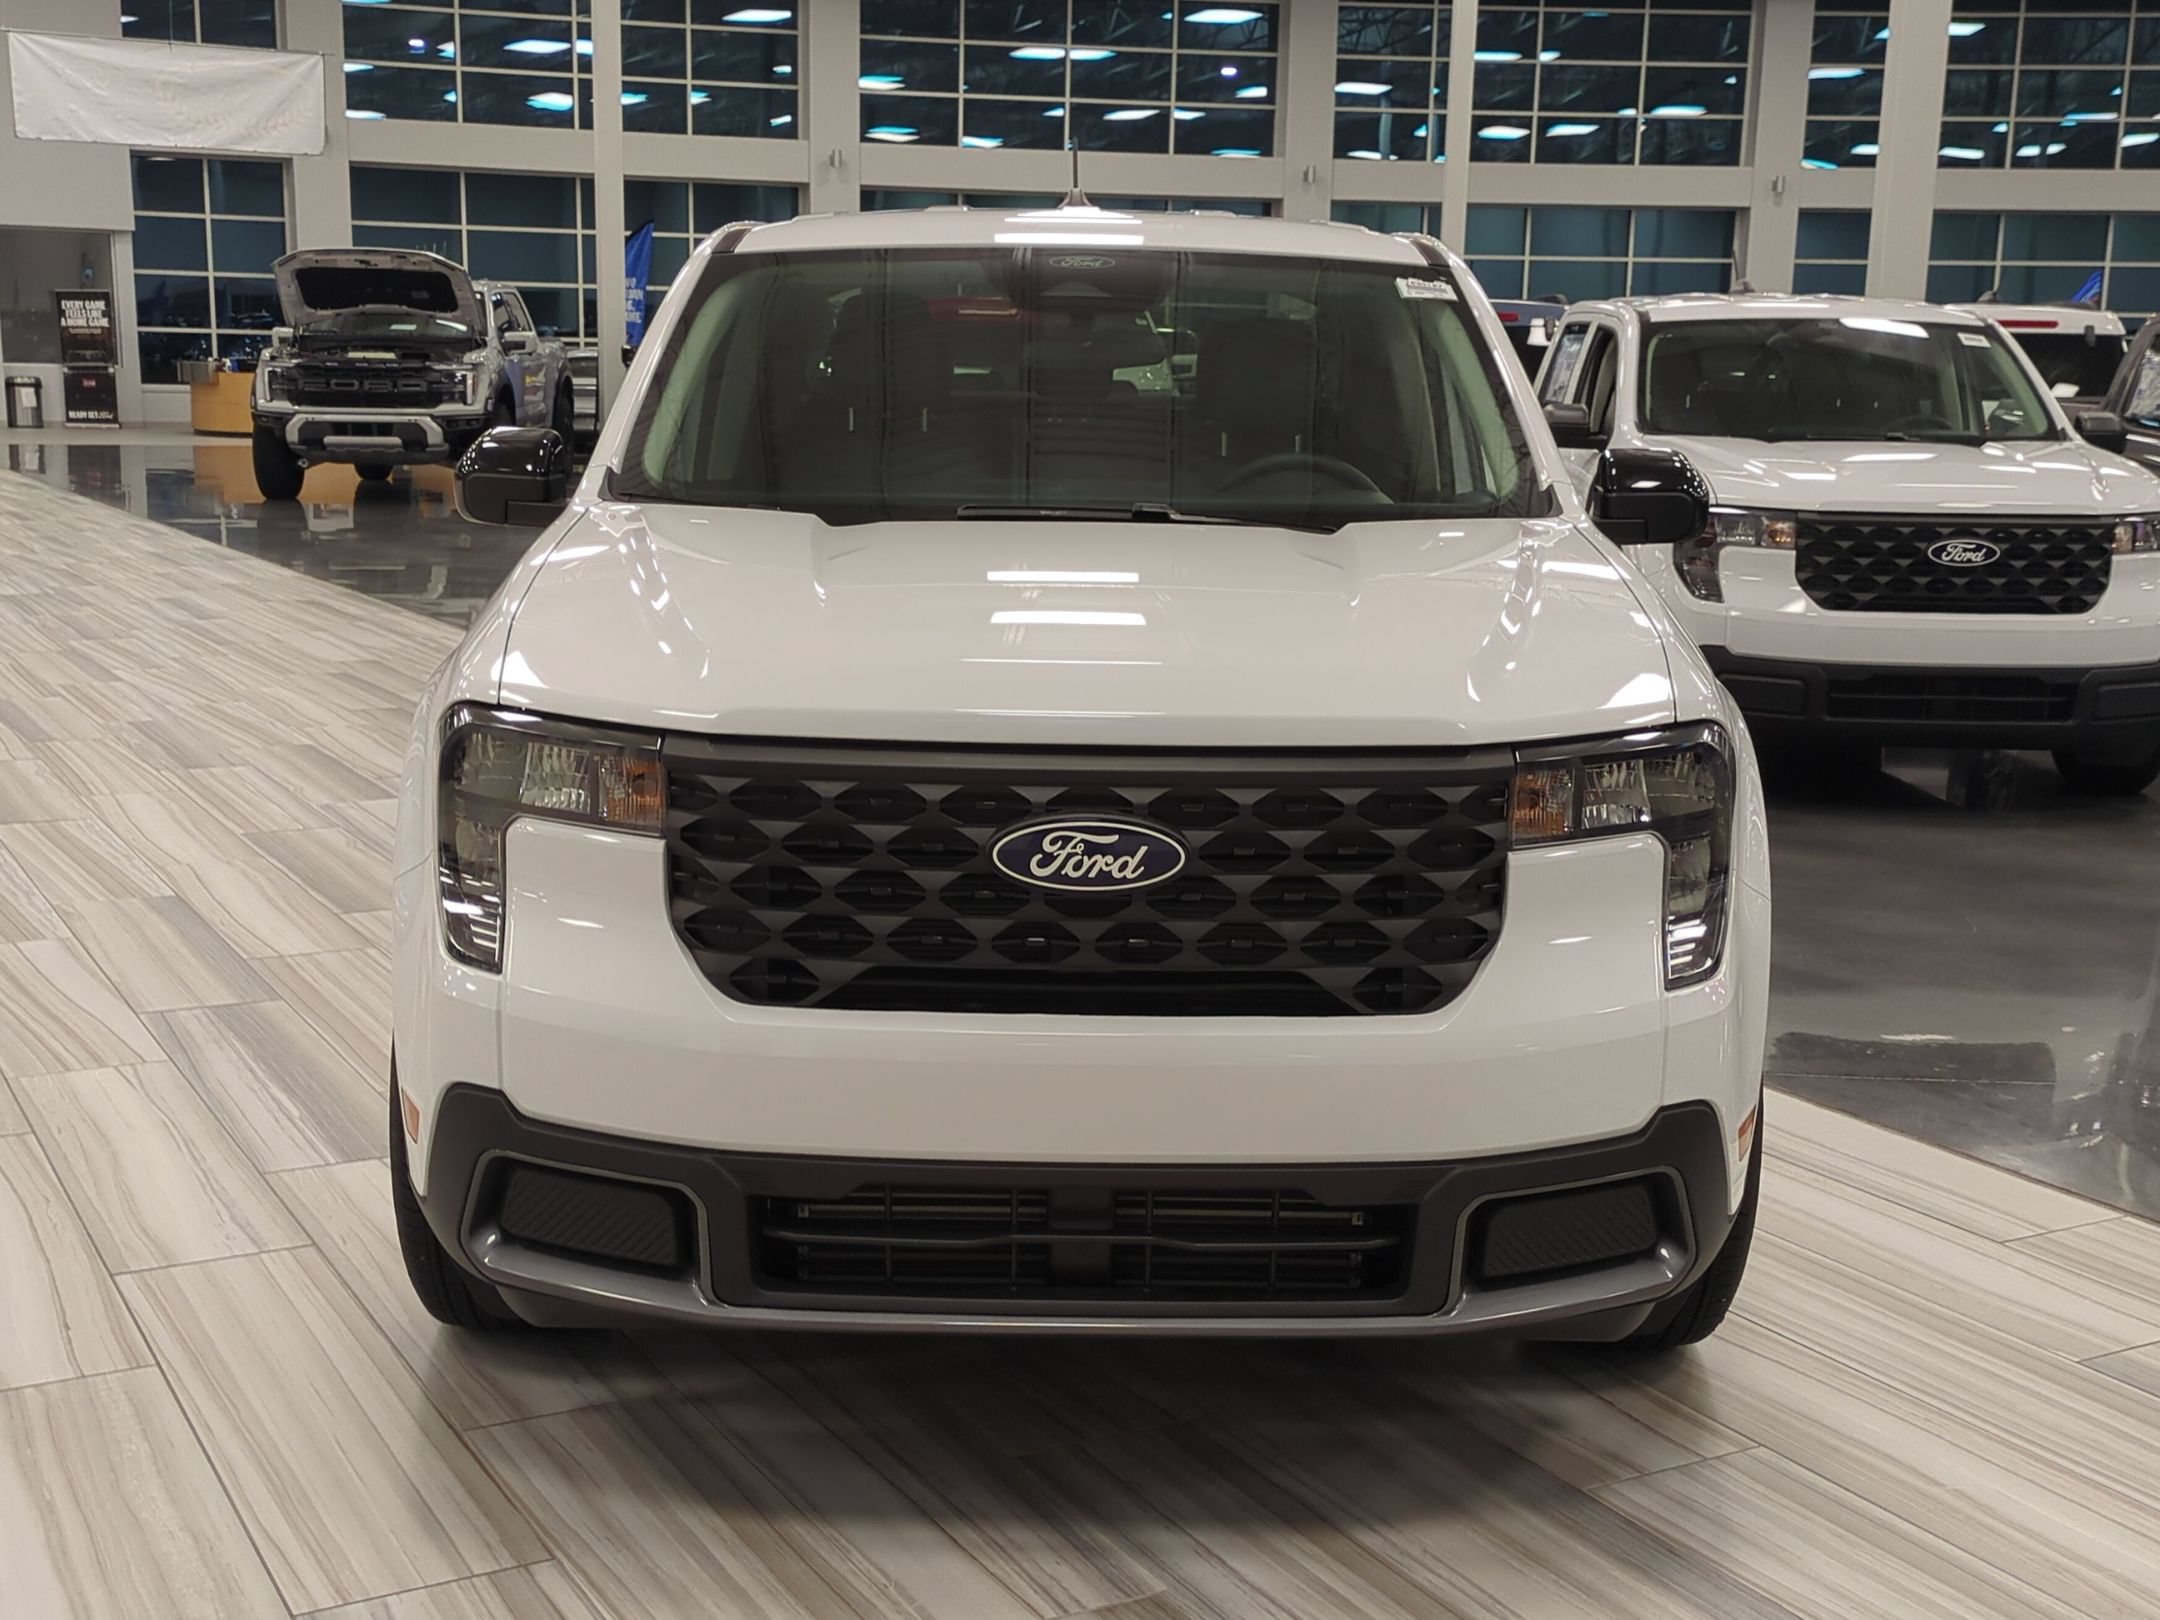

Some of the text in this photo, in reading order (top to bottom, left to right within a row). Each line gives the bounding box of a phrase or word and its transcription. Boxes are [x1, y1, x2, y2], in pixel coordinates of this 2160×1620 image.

[1061, 256, 1103, 269] Ford
[61, 300, 106, 310] EVERY GAME
[65, 309, 103, 318] FEELS LIKE
[60, 317, 109, 327] A HOME GAME
[298, 378, 427, 392] FORD
[1941, 543, 1986, 562] Ford
[1029, 830, 1149, 880] Ford
